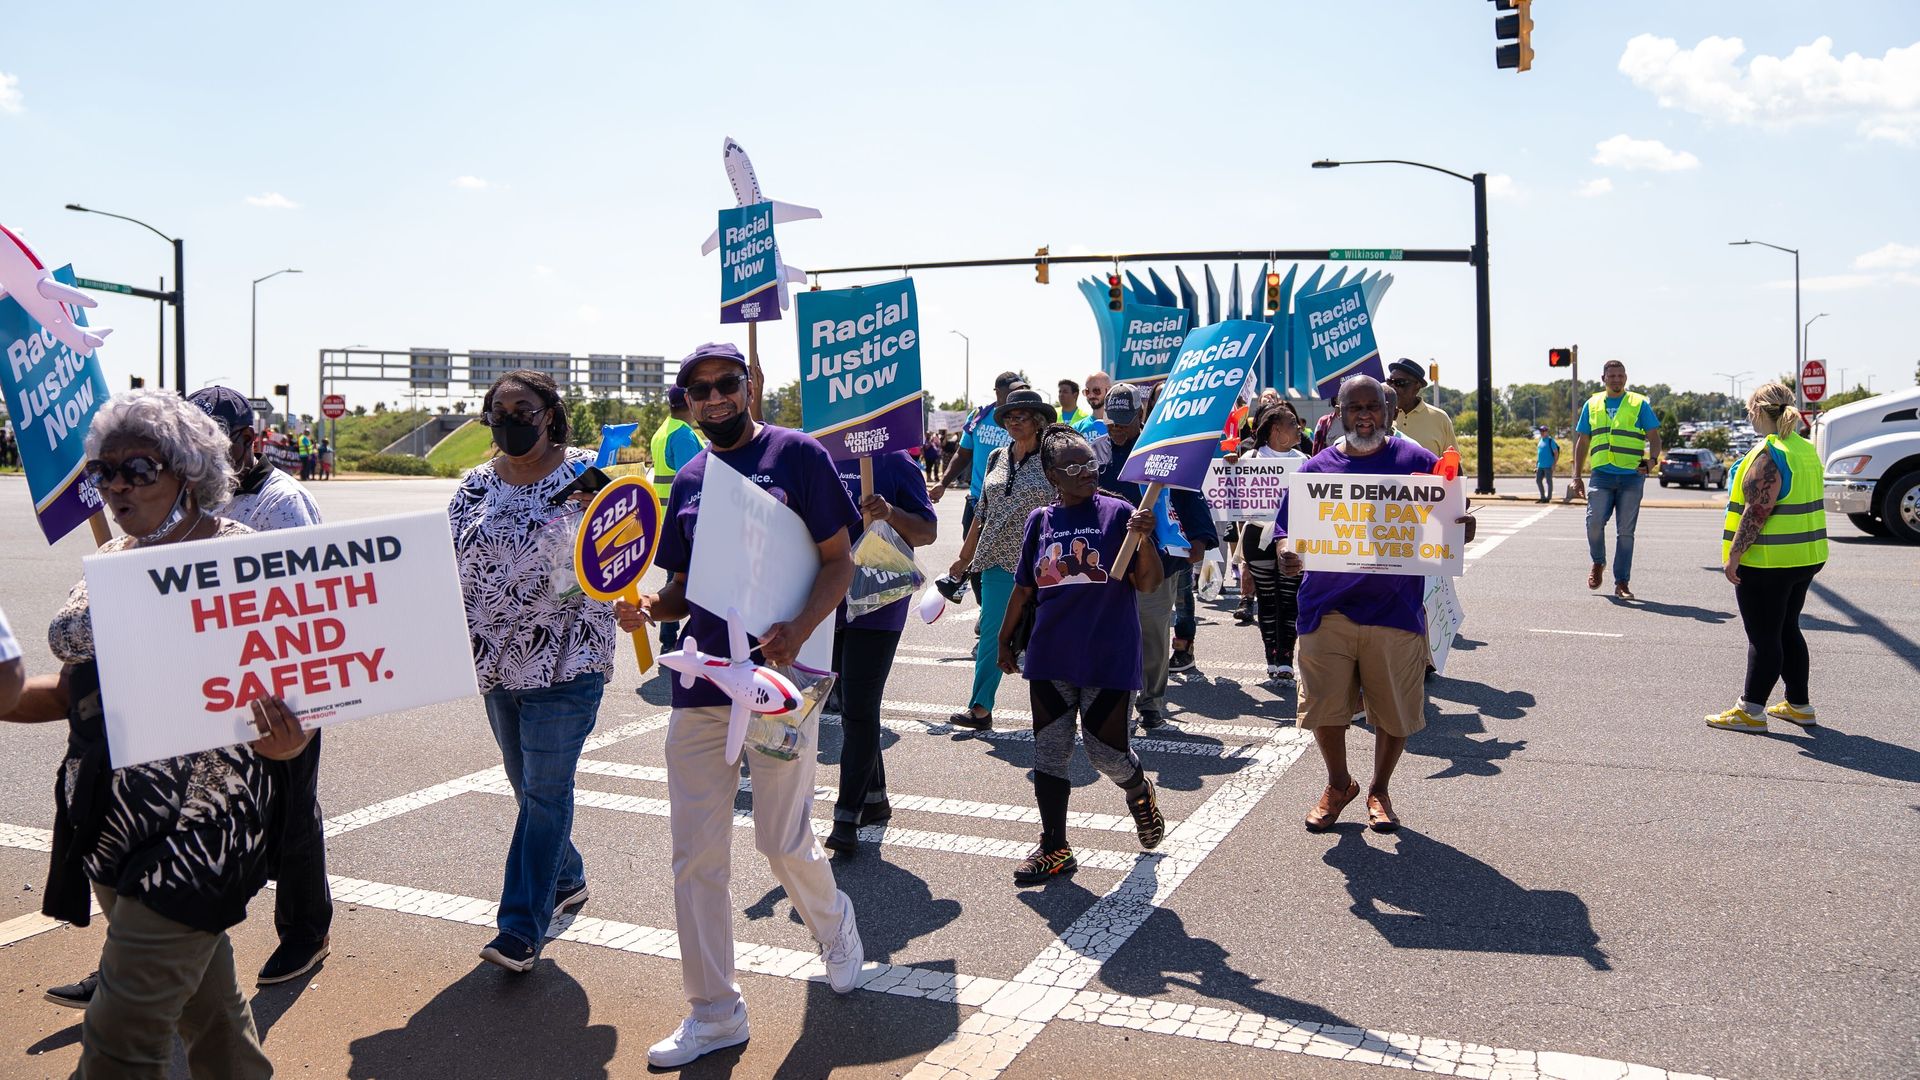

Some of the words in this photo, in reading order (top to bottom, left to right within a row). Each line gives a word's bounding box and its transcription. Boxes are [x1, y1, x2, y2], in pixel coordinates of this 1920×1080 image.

[726, 210, 769, 246] Racial
[724, 236, 773, 268] Justice
[1345, 250, 1384, 259] Wilkinson
[734, 258, 765, 283] Now
[812, 292, 908, 348] Racial
[1309, 291, 1360, 329] Racial
[1128, 315, 1183, 334] Racial
[1312, 312, 1368, 350] Justice
[806, 329, 916, 382] Justice
[1122, 334, 1182, 352] Justice
[1174, 333, 1256, 375] Racial
[1324, 333, 1360, 361] Now
[1131, 352, 1170, 366] Now
[20, 344, 94, 431] Justic
[829, 362, 898, 403] Now
[1158, 365, 1244, 404] Justice
[1806, 386, 1821, 394] ENTER
[43, 376, 95, 451] Now
[1156, 396, 1216, 424] Now
[844, 434, 889, 448] WORKERS
[845, 427, 887, 440] AIRPORT
[851, 442, 884, 453] UNITED
[1147, 454, 1178, 463] AIRPORT
[1144, 461, 1177, 471] WORKERS
[1213, 467, 1231, 475] WE
[1235, 466, 1284, 474] DEMAND
[1208, 488, 1289, 498] CONSISTENT
[1218, 477, 1246, 486] FAIR
[1250, 477, 1279, 486] AND
[1307, 484, 1343, 499] WE
[1350, 485, 1445, 502] DEMAND
[591, 488, 638, 541] 32BJ
[1207, 499, 1280, 509] SCHEDULIN
[1319, 502, 1376, 522] FAIR
[1385, 504, 1434, 524] PAY
[1334, 524, 1367, 539] WE
[1372, 525, 1415, 541] CAN
[602, 536, 645, 588] SEIU
[1296, 539, 1352, 555] BUILD
[1358, 542, 1414, 558] LIVES
[1419, 544, 1454, 560] ON.
[148, 560, 221, 595] WE
[233, 535, 402, 584] DEMAND
[191, 572, 377, 633] HEALTH
[239, 618, 346, 666] AND
[202, 648, 394, 713] SAFETY.
[334, 699, 362, 708] WORKERS
